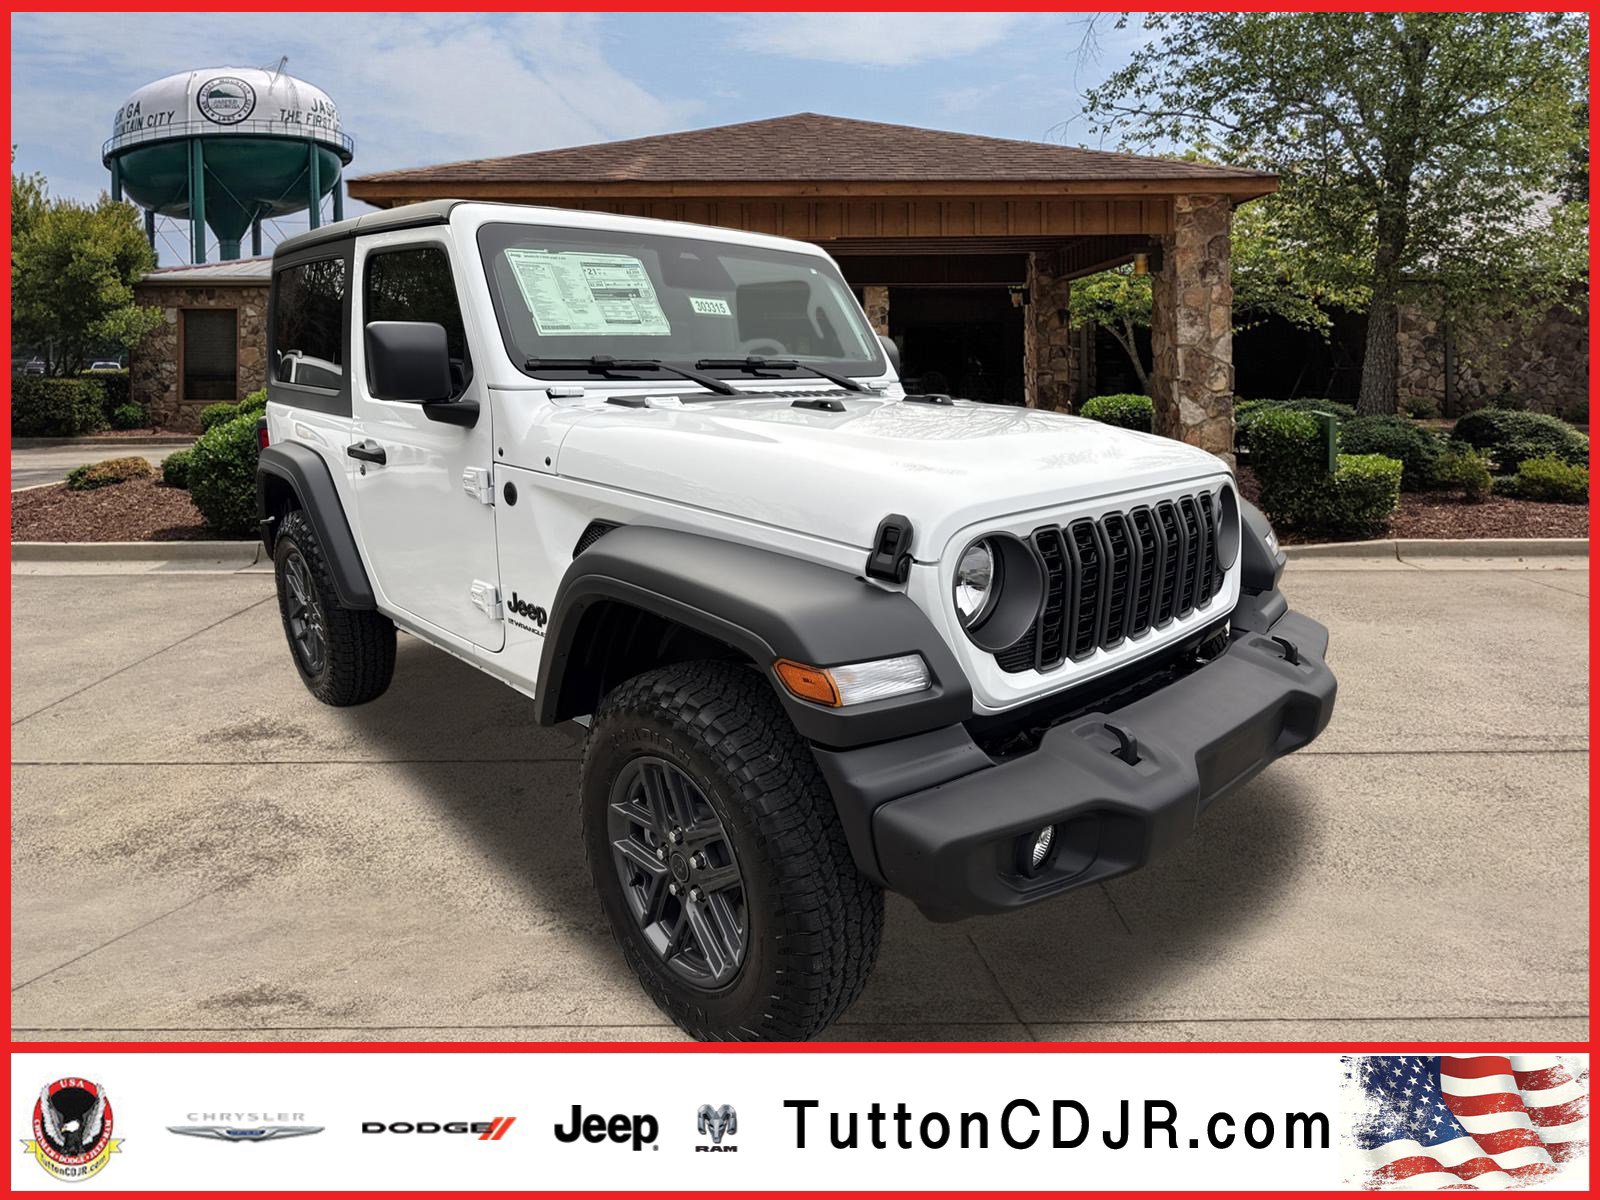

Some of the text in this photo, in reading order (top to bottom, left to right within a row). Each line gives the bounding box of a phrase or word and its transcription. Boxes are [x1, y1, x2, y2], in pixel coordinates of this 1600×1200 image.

[126, 101, 141, 118] GA
[147, 110, 175, 127] CITY
[280, 109, 302, 123] THE
[306, 113, 332, 129] FIRST
[695, 300, 726, 314] 303315
[507, 592, 547, 628] Jeep
